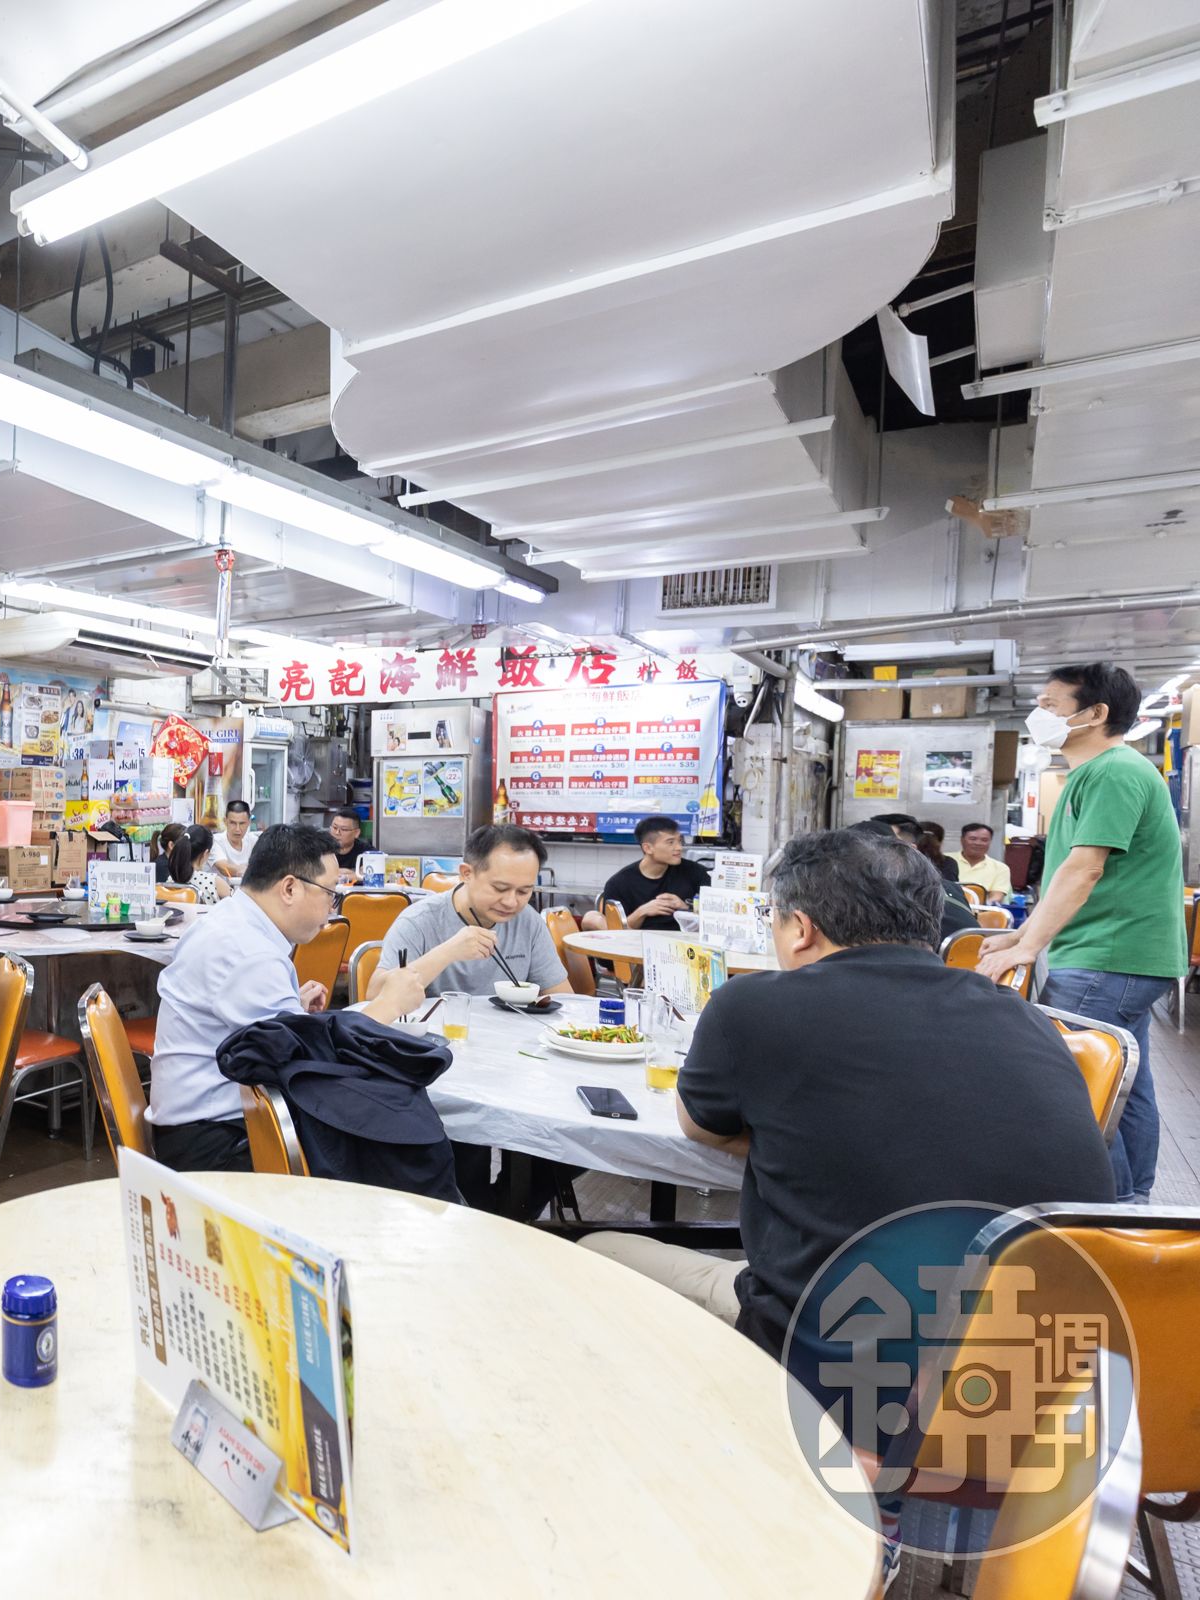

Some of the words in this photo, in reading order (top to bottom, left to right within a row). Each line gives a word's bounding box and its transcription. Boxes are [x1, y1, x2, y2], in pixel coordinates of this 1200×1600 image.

[279, 644, 618, 702] 亮記海鮮飯店
[216, 729, 240, 737] GIRL
[119, 759, 138, 771] Asahi
[92, 779, 113, 791] Asahi
